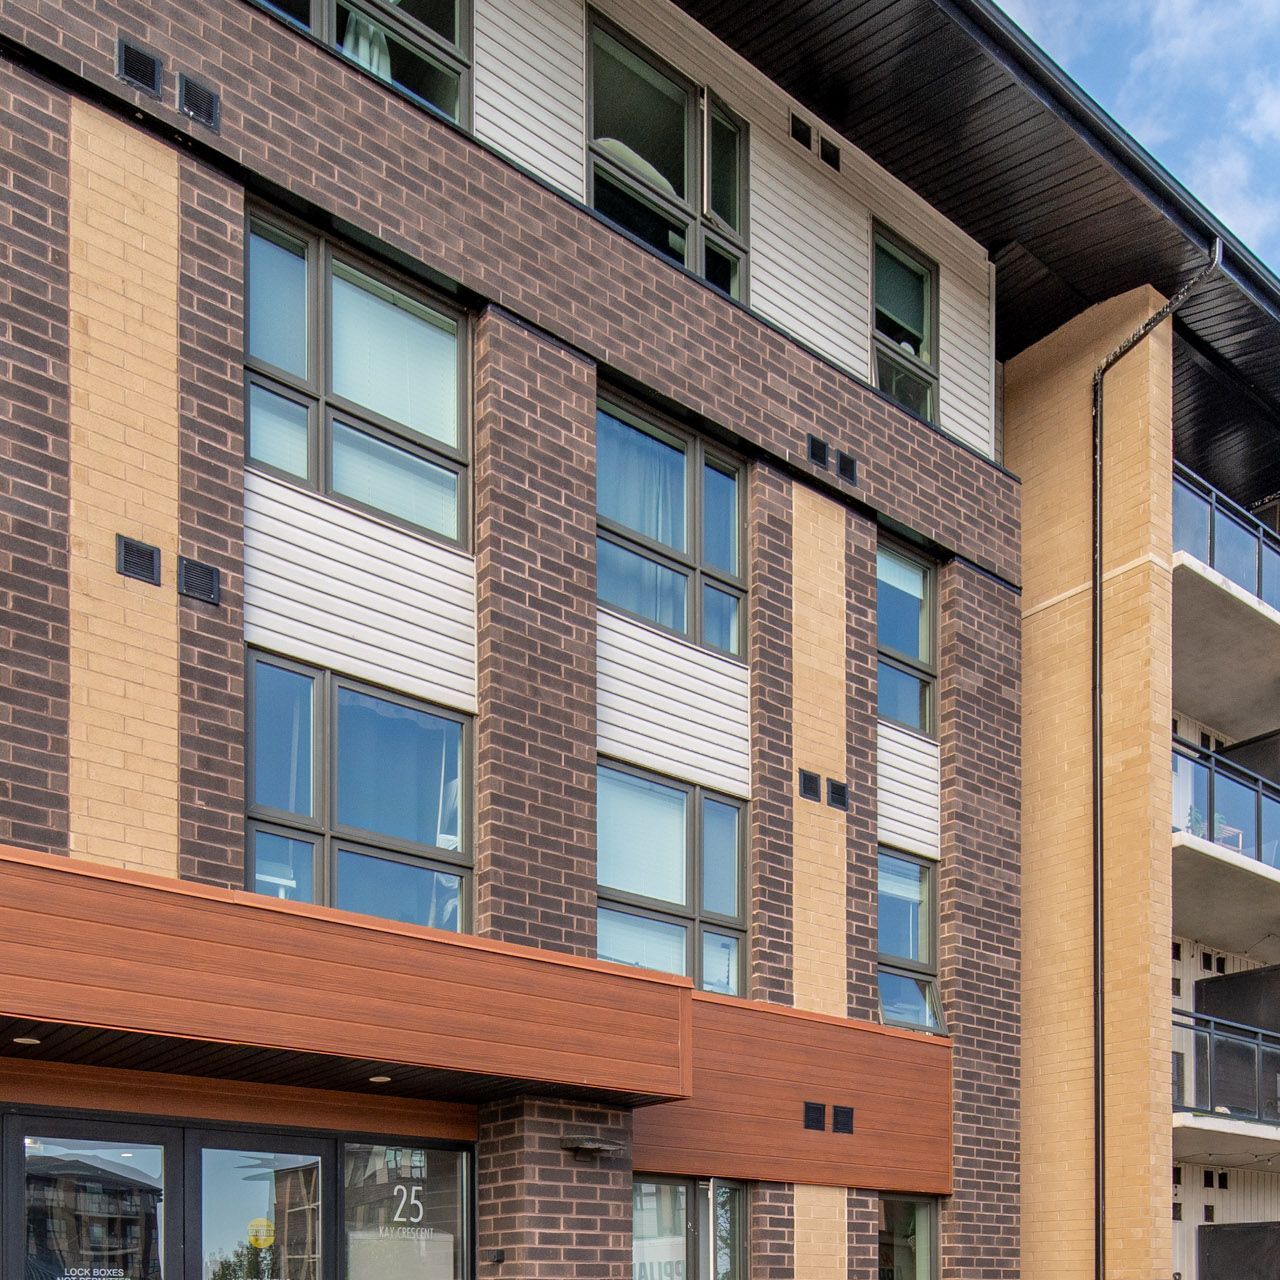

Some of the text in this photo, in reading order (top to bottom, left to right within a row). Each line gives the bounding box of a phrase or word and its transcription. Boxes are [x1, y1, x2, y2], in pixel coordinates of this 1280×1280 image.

[393, 1184, 424, 1223] 25
[379, 1226, 434, 1240] KAY CRESCENT
[64, 1268, 125, 1277] LOCK BOXES
